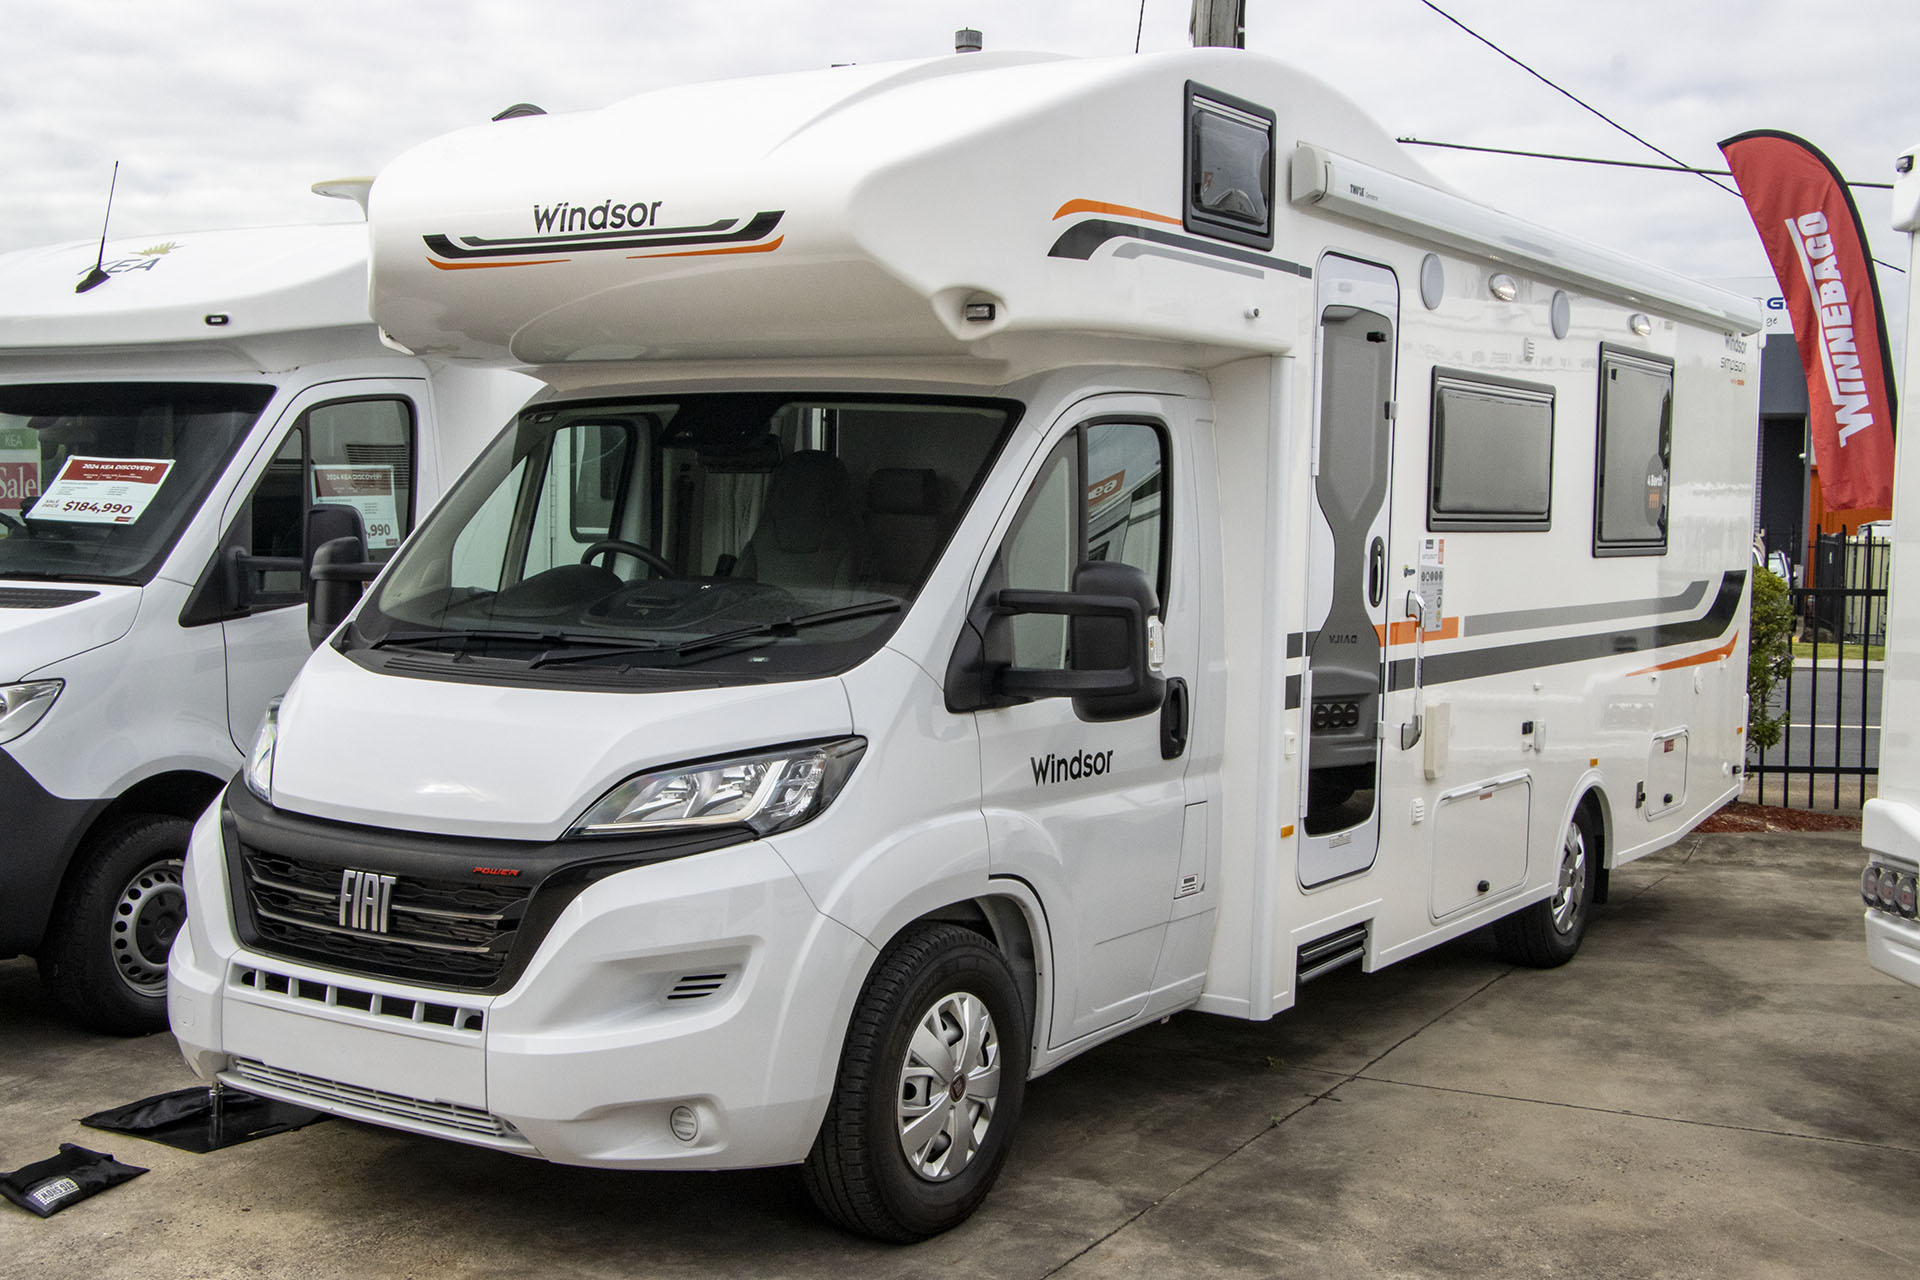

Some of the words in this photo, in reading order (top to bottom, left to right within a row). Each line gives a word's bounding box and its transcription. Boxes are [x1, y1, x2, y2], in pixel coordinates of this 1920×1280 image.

[534, 199, 663, 234] Windsor
[1767, 297, 1789, 309] G
[1785, 211, 1874, 448] WINNEBAGO
[115, 464, 155, 472] DISCOVERY
[62, 500, 133, 514] $184,990
[366, 524, 391, 539] ,990
[1030, 749, 1113, 787] Windsor
[472, 866, 520, 876] POWER
[338, 869, 397, 933] FIAT
